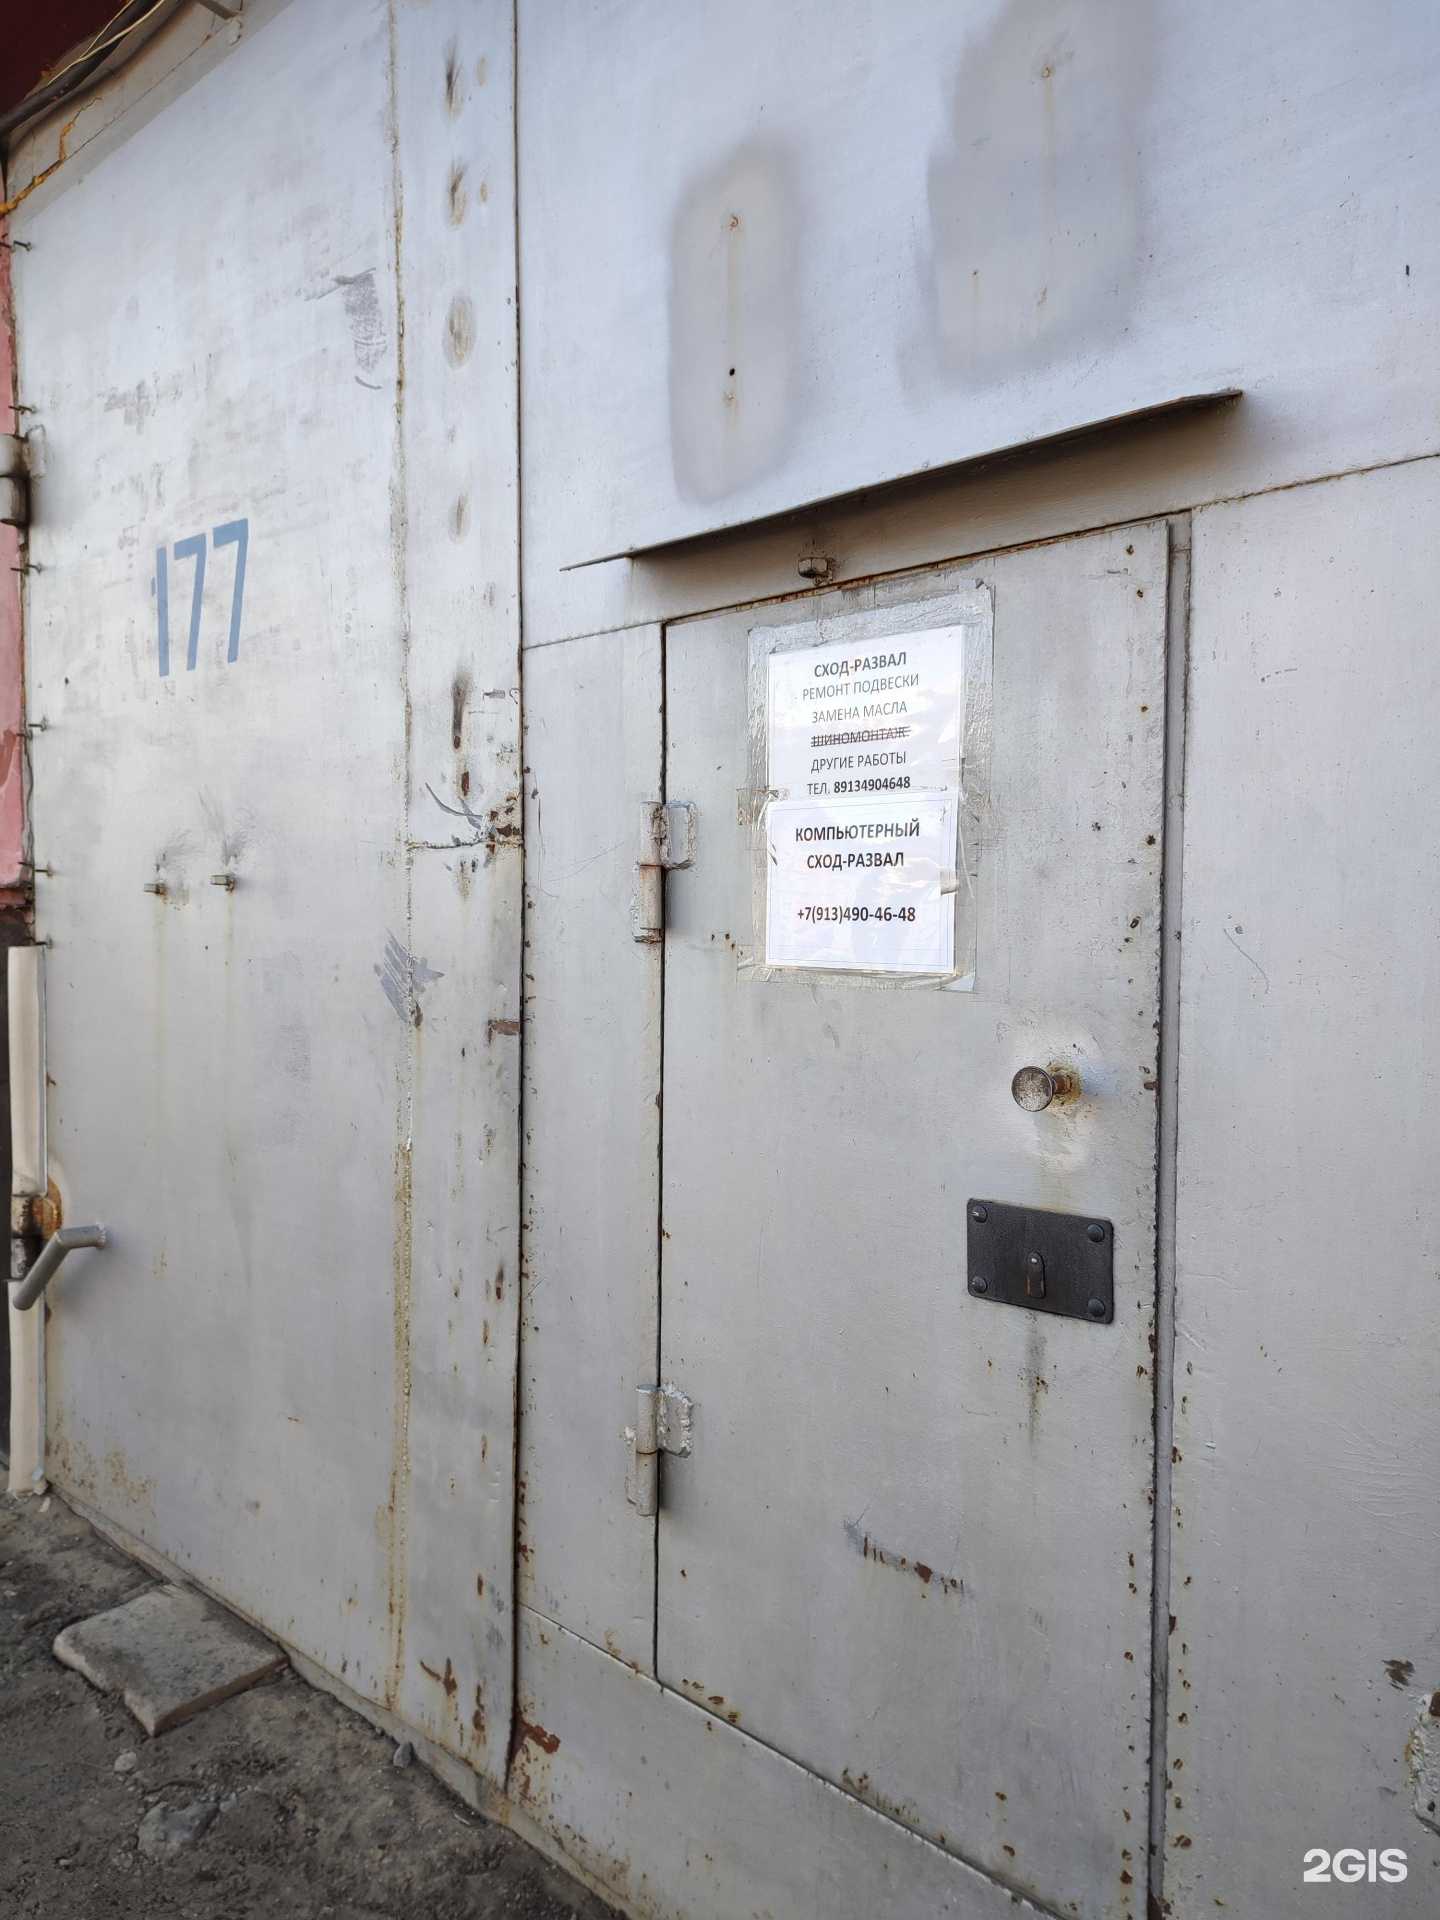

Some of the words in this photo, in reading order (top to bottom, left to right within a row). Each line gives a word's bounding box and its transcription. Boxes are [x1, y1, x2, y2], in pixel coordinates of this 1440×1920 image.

[151, 518, 249, 677] 177
[814, 652, 907, 678] СХОД-РАЗВАЛ
[802, 682, 850, 701] РЕМОНТ
[853, 673, 919, 694] ПОДВЕСКИ
[812, 706, 860, 723] ЗАМЕНА
[863, 701, 908, 719] МАСЛА
[811, 755, 854, 774] ДРУГИЕ
[857, 751, 907, 769] РАБОТЫ
[807, 782, 831, 796] ТЕЛ.
[833, 776, 911, 794] 89134904648
[795, 818, 920, 842] КОМПЬЮТЕРНЫЙ
[807, 852, 904, 871] СХОД-РАЗВАЛ
[797, 905, 916, 924] +7(913)490-46-48
